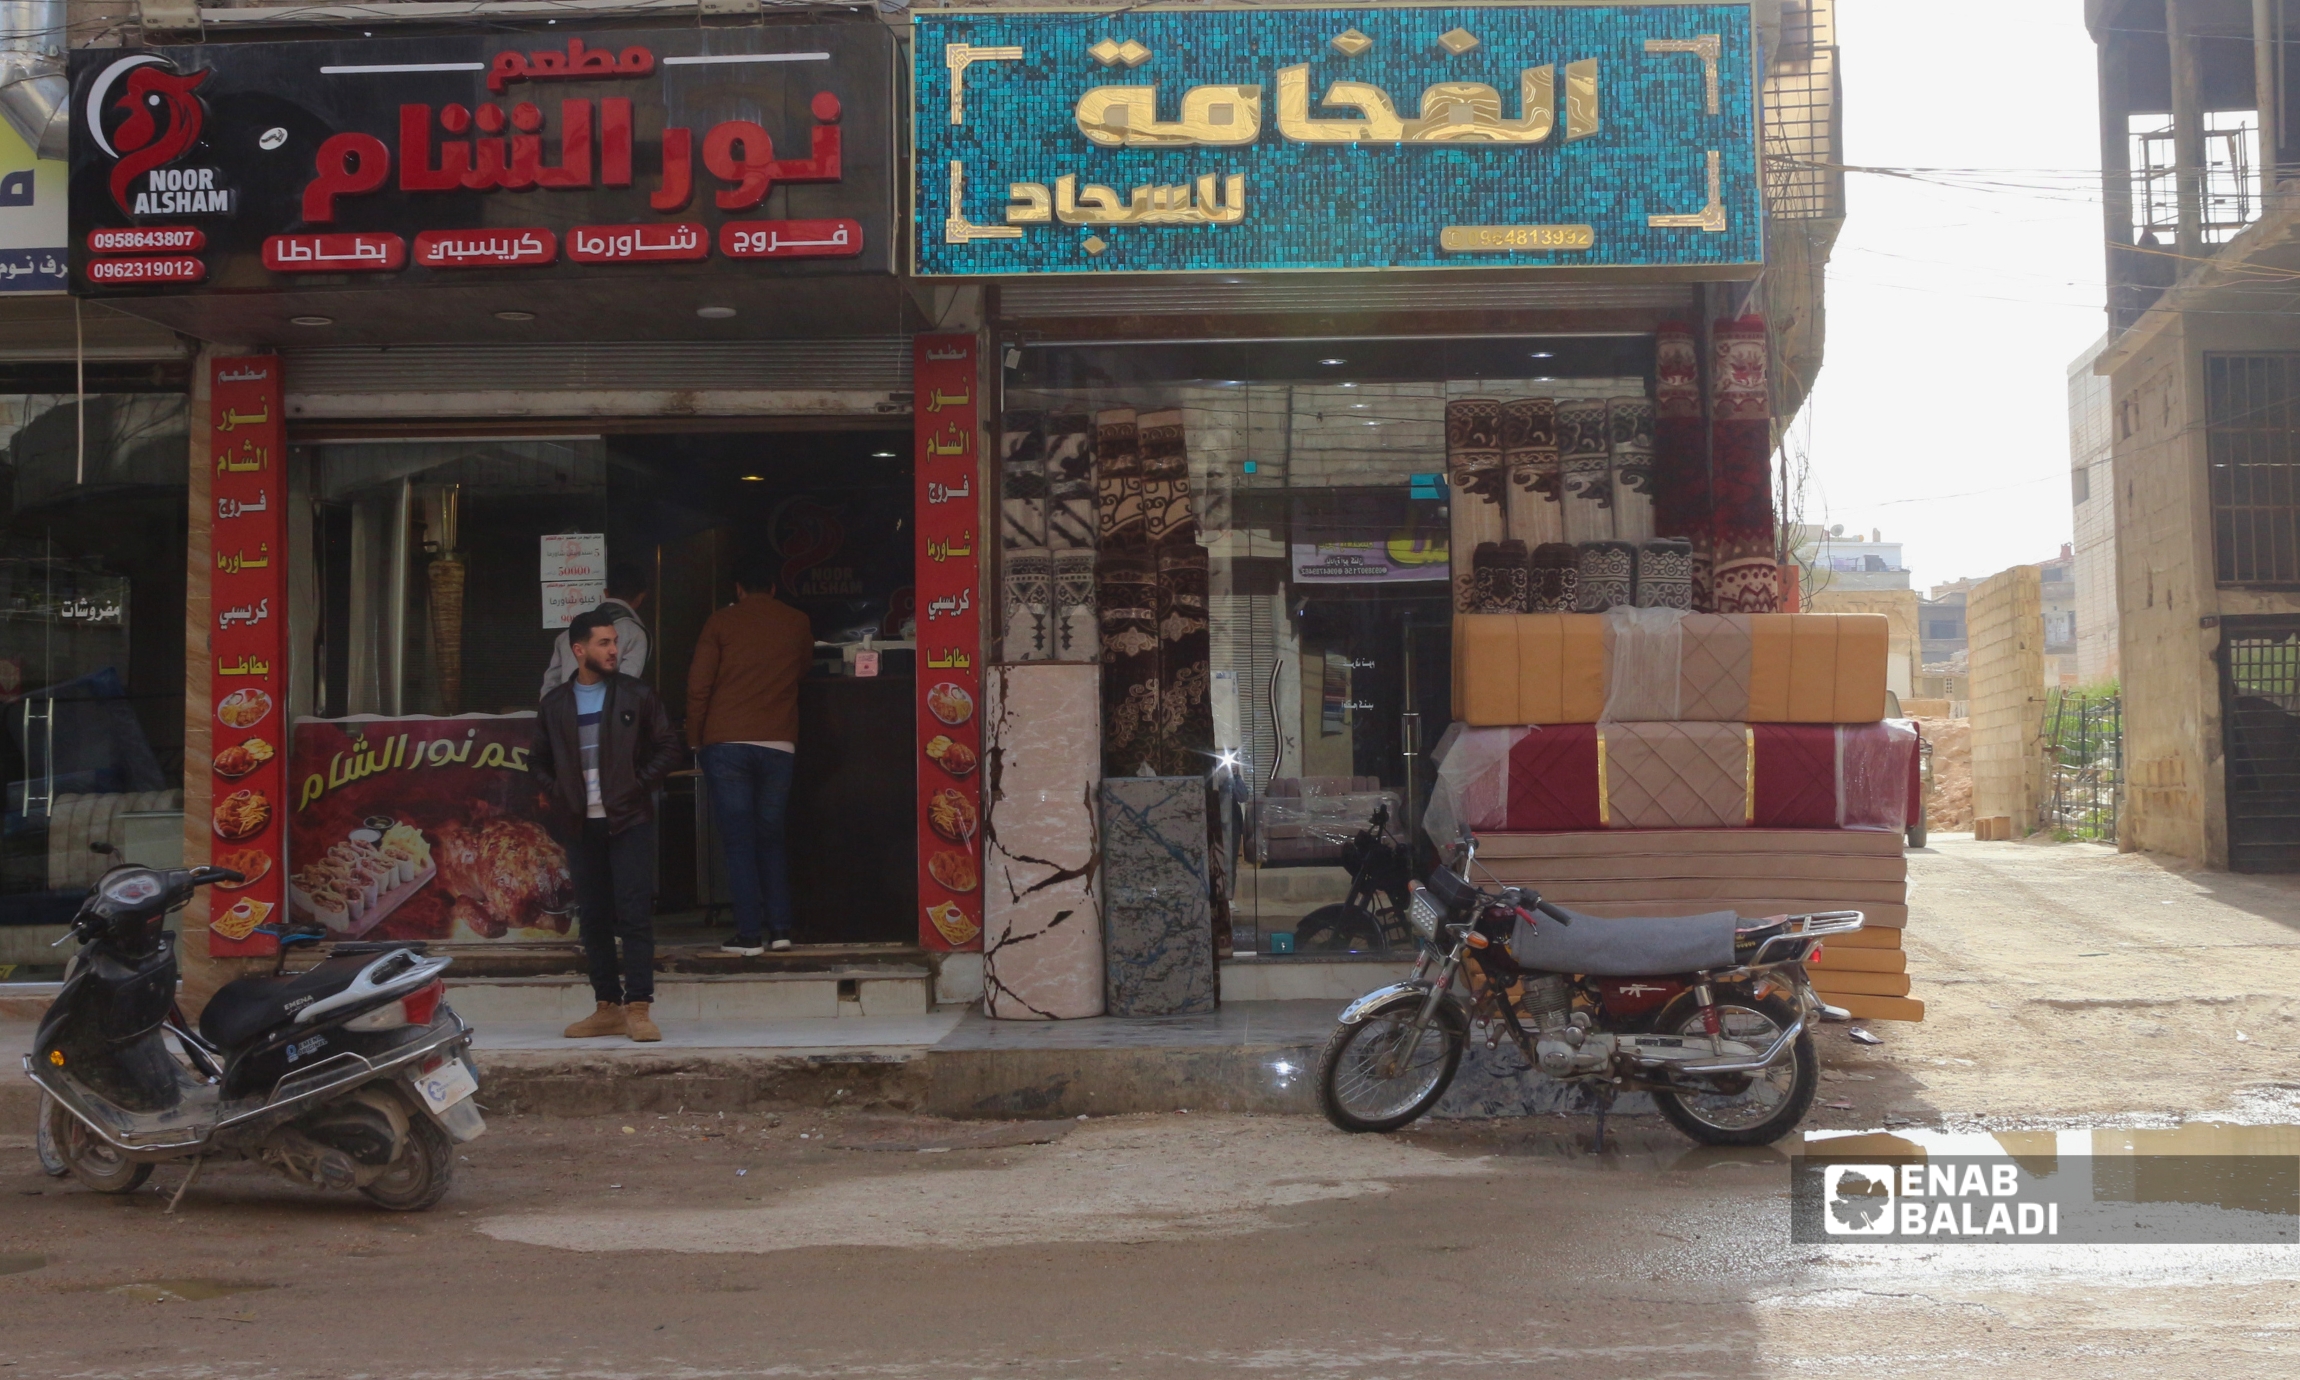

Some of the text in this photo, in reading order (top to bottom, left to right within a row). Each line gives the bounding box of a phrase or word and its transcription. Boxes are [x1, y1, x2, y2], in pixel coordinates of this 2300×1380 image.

[487, 37, 656, 94] مطعم
[1075, 27, 1598, 147] الفخامة
[302, 91, 842, 223] نور الشام
[150, 168, 213, 191] NOOR
[134, 190, 228, 214] ALSHAM
[1006, 172, 1246, 255] للسجاد
[94, 232, 194, 248] 0958643807
[277, 222, 848, 264] فروج شاورما كريسبي بطاطا
[39, 254, 69, 278] رف
[94, 261, 194, 278] 0962319012
[925, 344, 967, 363] مطعم
[217, 366, 267, 384] مطعم
[926, 376, 970, 412] نور
[216, 396, 269, 431] نور
[926, 421, 970, 463] الشام
[217, 439, 268, 479] الشام
[928, 474, 969, 503] فروج
[218, 489, 267, 518] فروج
[217, 543, 269, 573] شاورما
[593, 548, 600, 557] 5
[927, 530, 971, 563] شاورما
[61, 598, 120, 621] مفروشات
[219, 598, 268, 630] كريسبي
[928, 588, 970, 622] كريسبي
[218, 655, 269, 681] بطاطا
[927, 648, 970, 675] بطاطا
[297, 728, 530, 812] عم نور الشام
[284, 995, 314, 1011] EMENA
